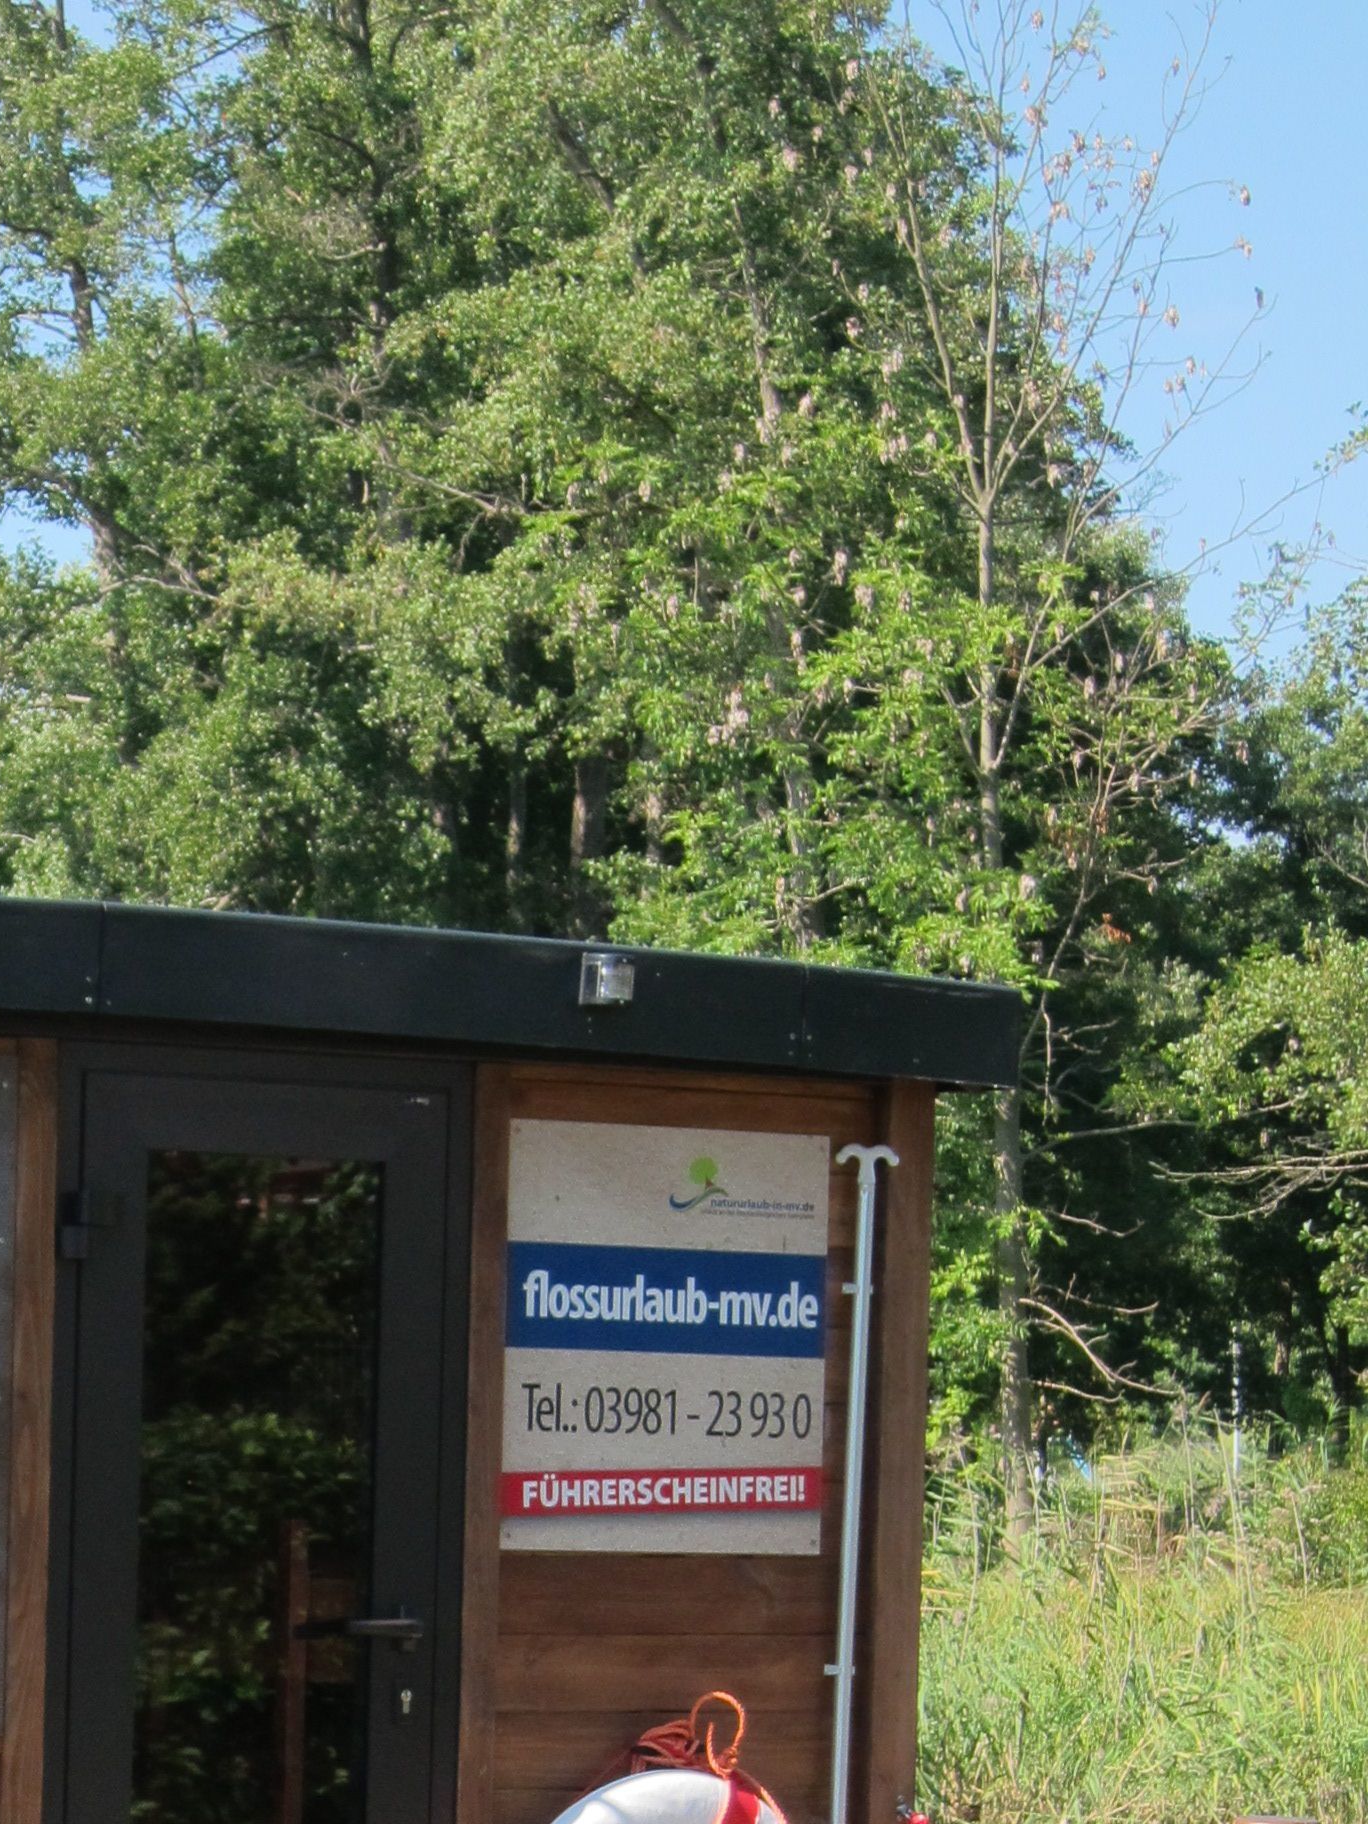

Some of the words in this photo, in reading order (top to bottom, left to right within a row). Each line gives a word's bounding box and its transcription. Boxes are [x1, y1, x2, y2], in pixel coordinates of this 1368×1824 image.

[522, 1269, 818, 1329] flossurlaub-mv.de
[521, 1383, 578, 1432] Tel.:
[584, 1386, 677, 1436] 03981
[522, 1473, 805, 1508] FÜHRERSCHEINFREI!
